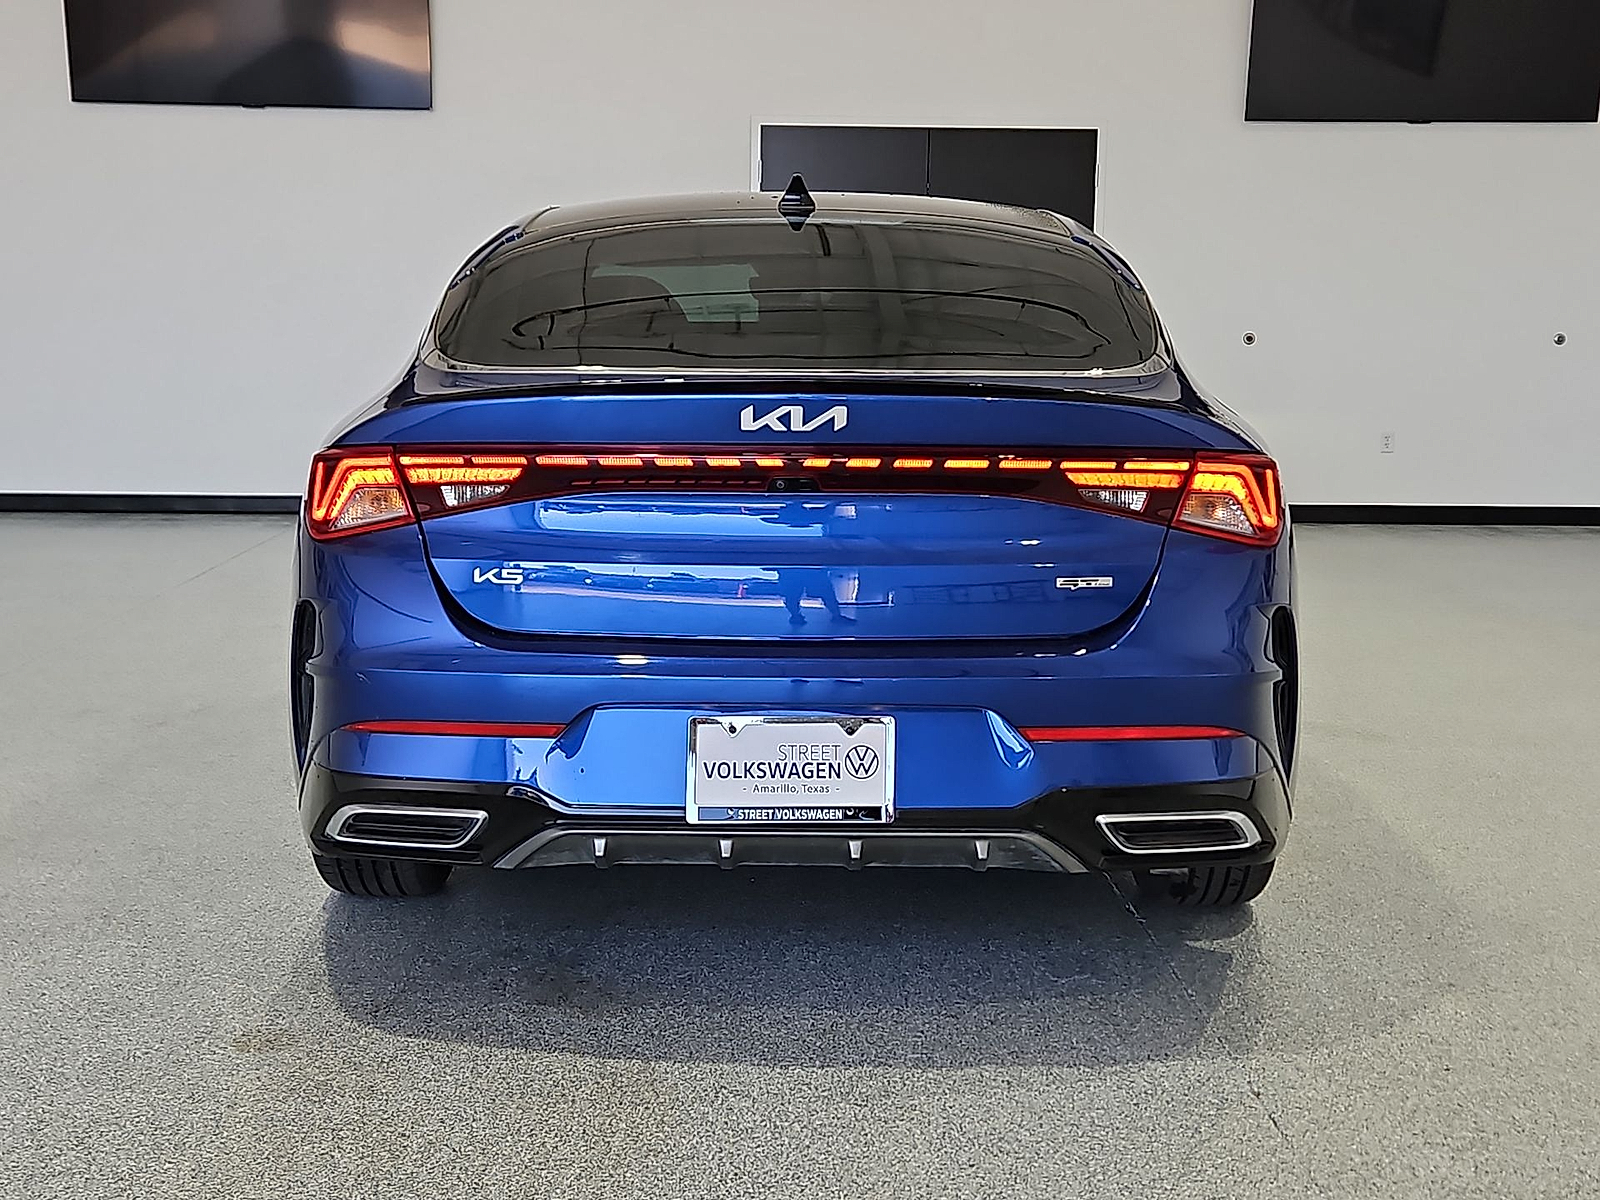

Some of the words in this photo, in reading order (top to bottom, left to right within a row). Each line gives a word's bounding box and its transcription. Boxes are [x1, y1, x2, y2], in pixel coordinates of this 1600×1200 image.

[741, 404, 847, 431] KIA
[473, 566, 524, 585] K5
[777, 744, 841, 761] STREET
[703, 761, 841, 779] VOLKSWAGEN
[752, 784, 800, 795] Amarillo,
[801, 784, 830, 794] Texas
[738, 808, 774, 820] STREET
[776, 808, 843, 820] VOLKSWAGEN
